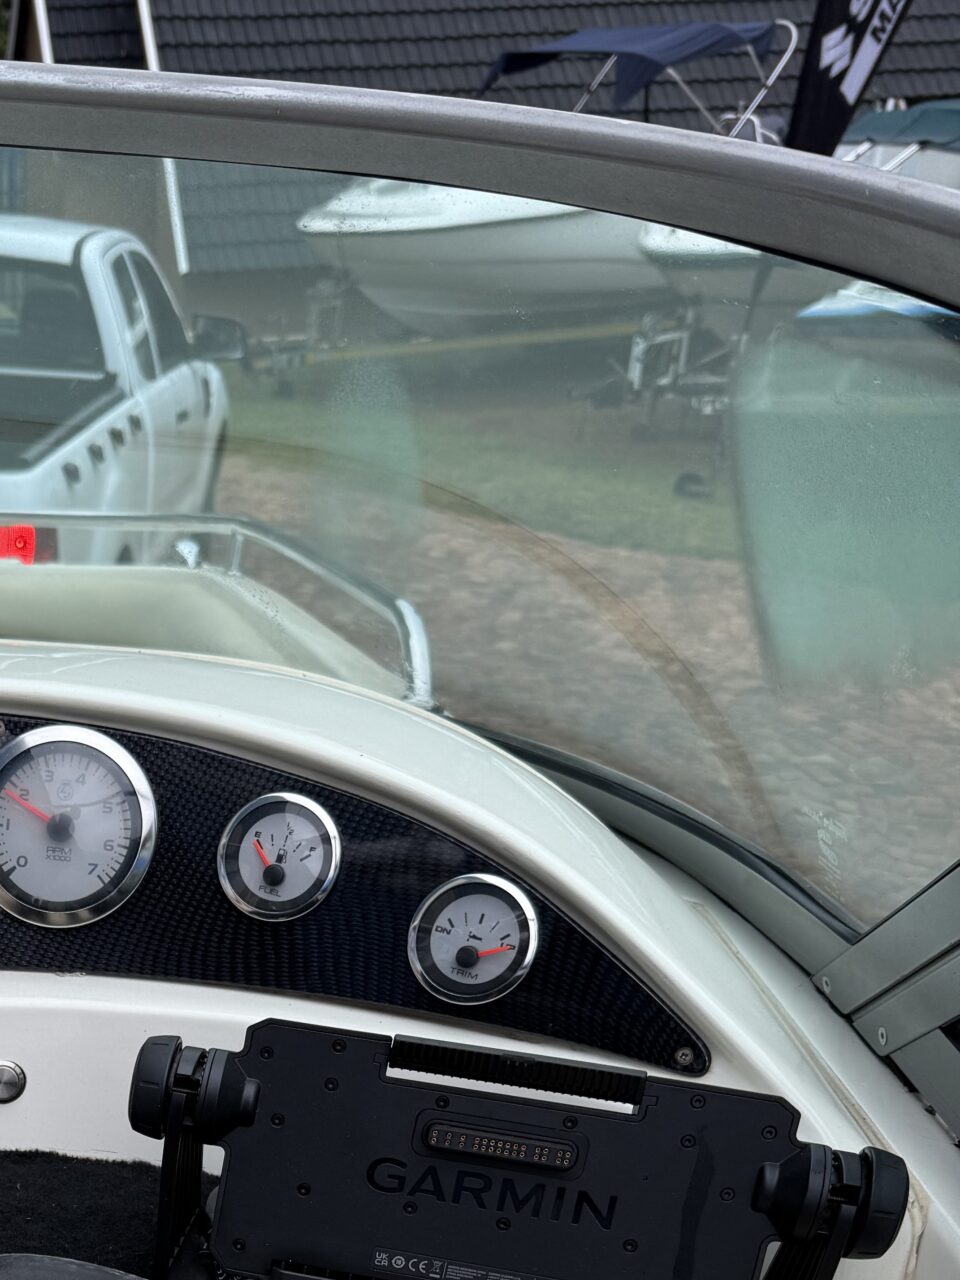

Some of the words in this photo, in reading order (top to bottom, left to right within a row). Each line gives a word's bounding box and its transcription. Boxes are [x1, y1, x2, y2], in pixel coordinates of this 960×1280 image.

[44, 770, 55, 782] 3
[75, 773, 86, 786] 4
[19, 788, 29, 801] 2
[102, 802, 113, 814] 5
[46, 846, 72, 856] RPM
[103, 839, 114, 851] 6
[16, 855, 28, 868] 0
[87, 863, 98, 875] 7
[258, 885, 282, 898] FUEL
[435, 925, 452, 935] DN
[450, 966, 479, 981] TRIM
[366, 1156, 619, 1231] GARMIN
[408, 1258, 428, 1274] CE
